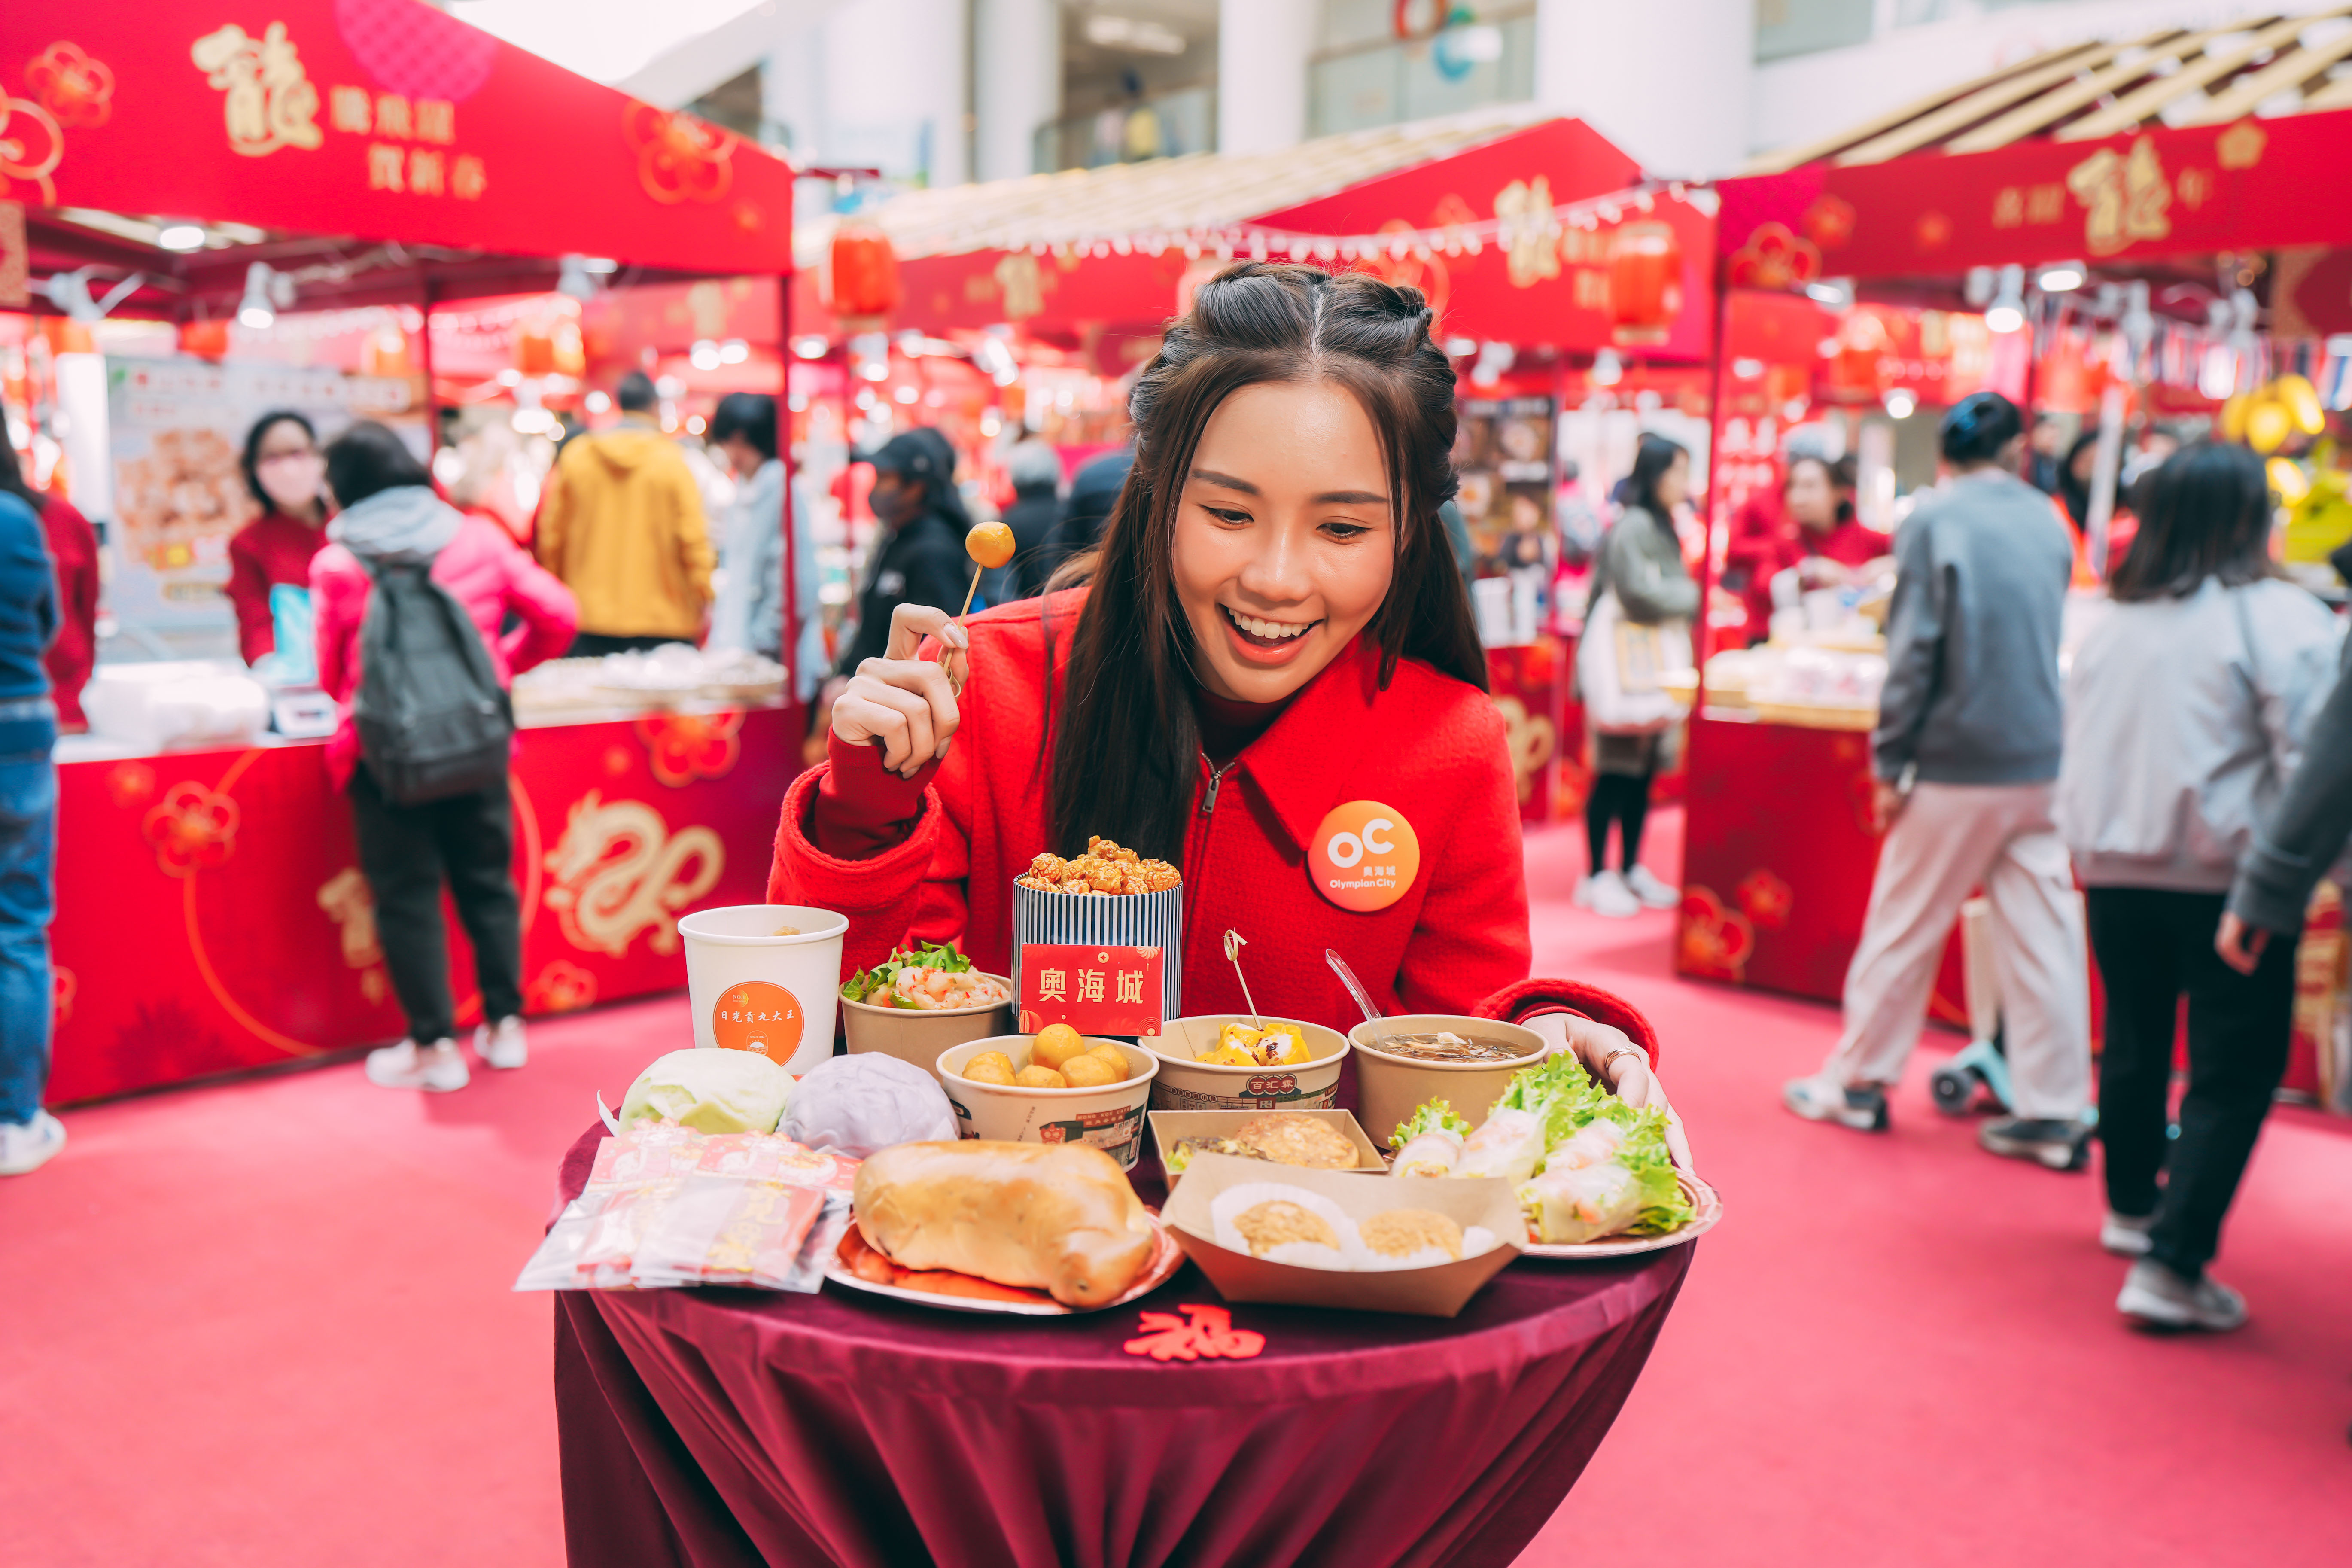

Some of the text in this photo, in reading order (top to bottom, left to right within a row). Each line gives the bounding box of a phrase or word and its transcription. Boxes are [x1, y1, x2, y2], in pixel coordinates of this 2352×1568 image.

[1330, 878, 1396, 890] Olympian City
[1038, 968, 1144, 1004] 奧海城
[721, 1009, 794, 1023] 日光貢丸大王
